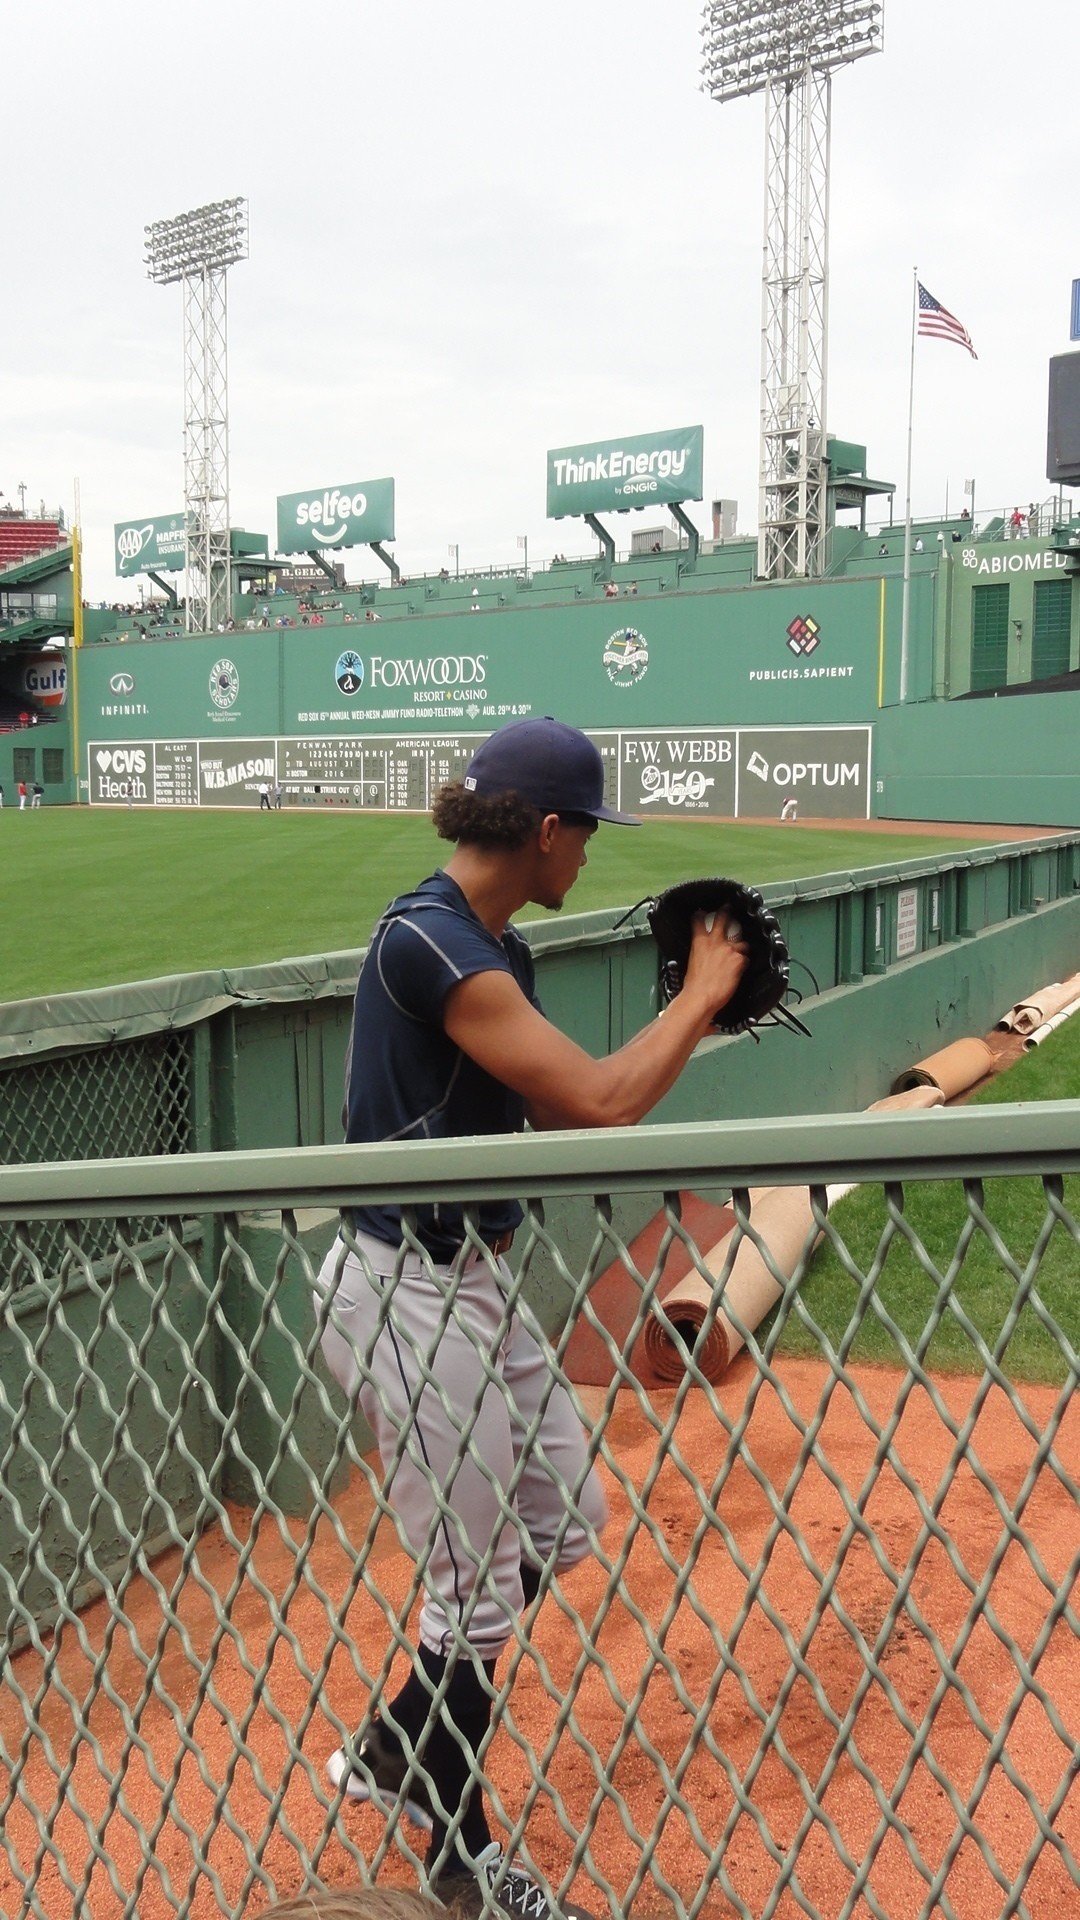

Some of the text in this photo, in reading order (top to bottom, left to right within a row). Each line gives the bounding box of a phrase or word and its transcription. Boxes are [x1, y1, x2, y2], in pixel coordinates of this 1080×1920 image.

[554, 448, 686, 486] ThinkEnergy
[614, 487, 622, 495] by
[296, 490, 367, 526] selfeo
[156, 529, 187, 543] MAPFR
[158, 543, 187, 555] INSURANC
[605, 627, 648, 650] BOSTON RED SOX
[221, 661, 234, 674] SOX
[370, 655, 486, 687] FOXWOODS
[750, 666, 854, 680] PUBLICIS.SAPIENT
[25, 668, 66, 691] Gulf
[414, 689, 488, 702] RESORT CASINO
[101, 705, 147, 716] INFINITI
[298, 713, 308, 722] RED
[308, 712, 318, 721] SOX
[330, 712, 350, 720] ANNUAL
[381, 710, 400, 719] JIMMY
[400, 709, 415, 718] FUND
[416, 707, 464, 717] RADIO-TELETHON
[482, 706, 496, 716] AUG.
[498, 705, 510, 715] 29TH
[512, 705, 517, 715] &
[518, 704, 532, 714] 30TH
[112, 750, 146, 773] CVS
[624, 740, 732, 763] F.W. WEBB
[773, 764, 859, 786] OPTUM
[98, 776, 147, 798] Heath
[660, 770, 706, 805] 150
